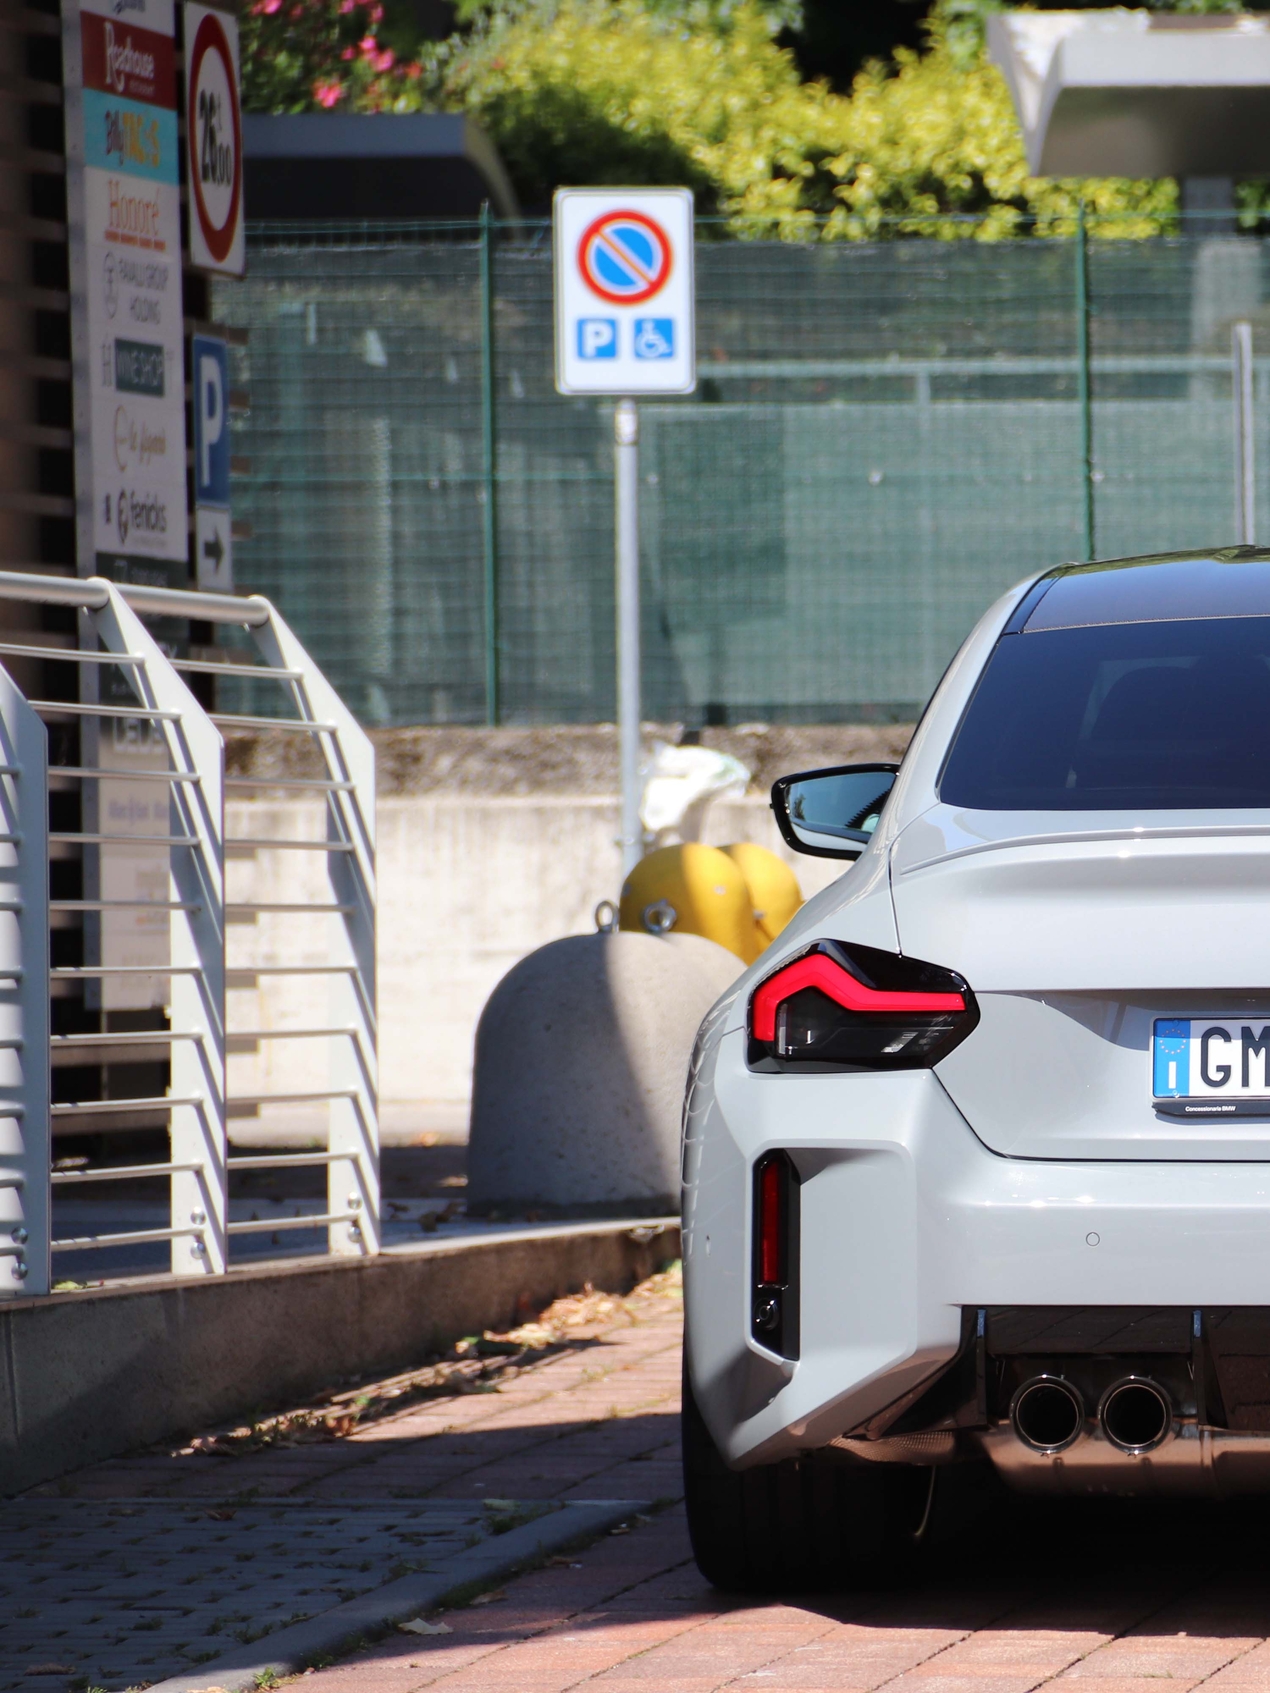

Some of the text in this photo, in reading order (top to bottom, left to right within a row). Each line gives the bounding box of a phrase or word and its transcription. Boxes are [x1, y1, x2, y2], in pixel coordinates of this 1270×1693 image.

[107, 179, 160, 235] Honoré
[582, 321, 613, 358] P
[201, 354, 223, 487] P
[1185, 1104, 1221, 1113] Concessionaria
